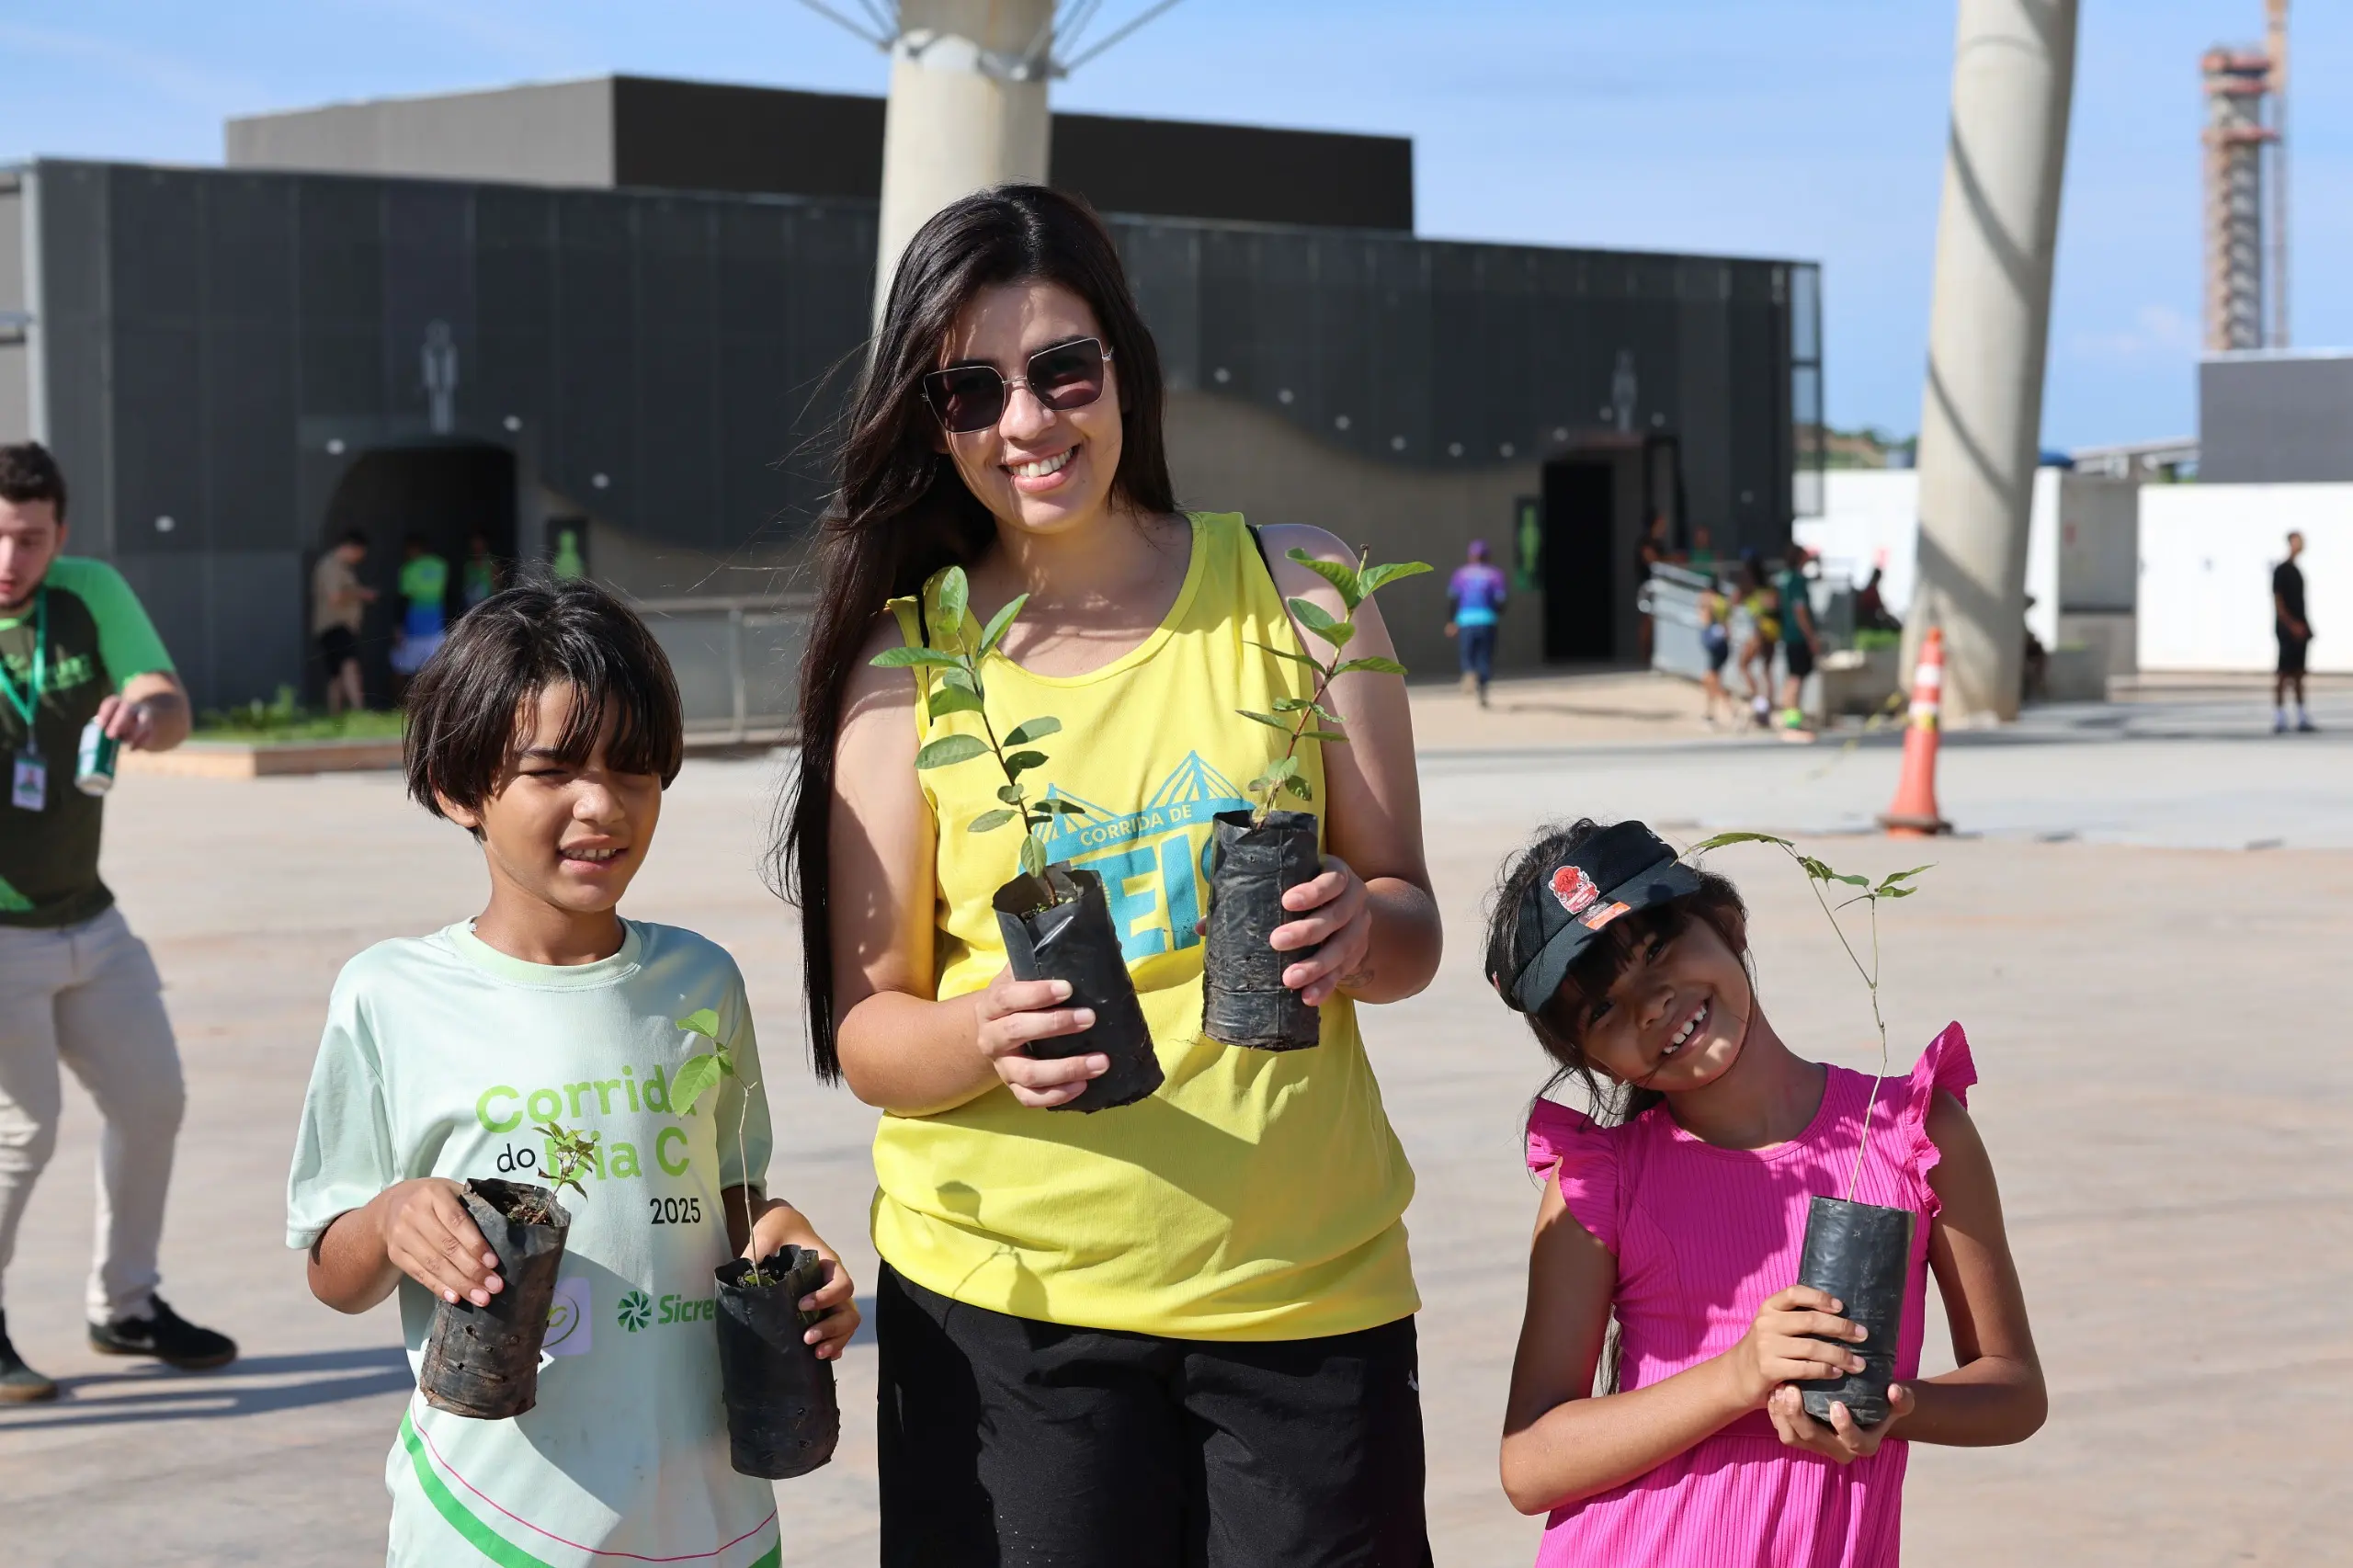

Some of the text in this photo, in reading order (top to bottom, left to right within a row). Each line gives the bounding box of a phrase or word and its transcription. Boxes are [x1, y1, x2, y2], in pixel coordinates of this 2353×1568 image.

[1079, 804, 1192, 847] CORRIDA DE
[475, 1064, 697, 1134] Corrid
[496, 1142, 536, 1173] do
[655, 1126, 690, 1176] C
[649, 1198, 701, 1225] 2025
[657, 1293, 717, 1325] Sicre
